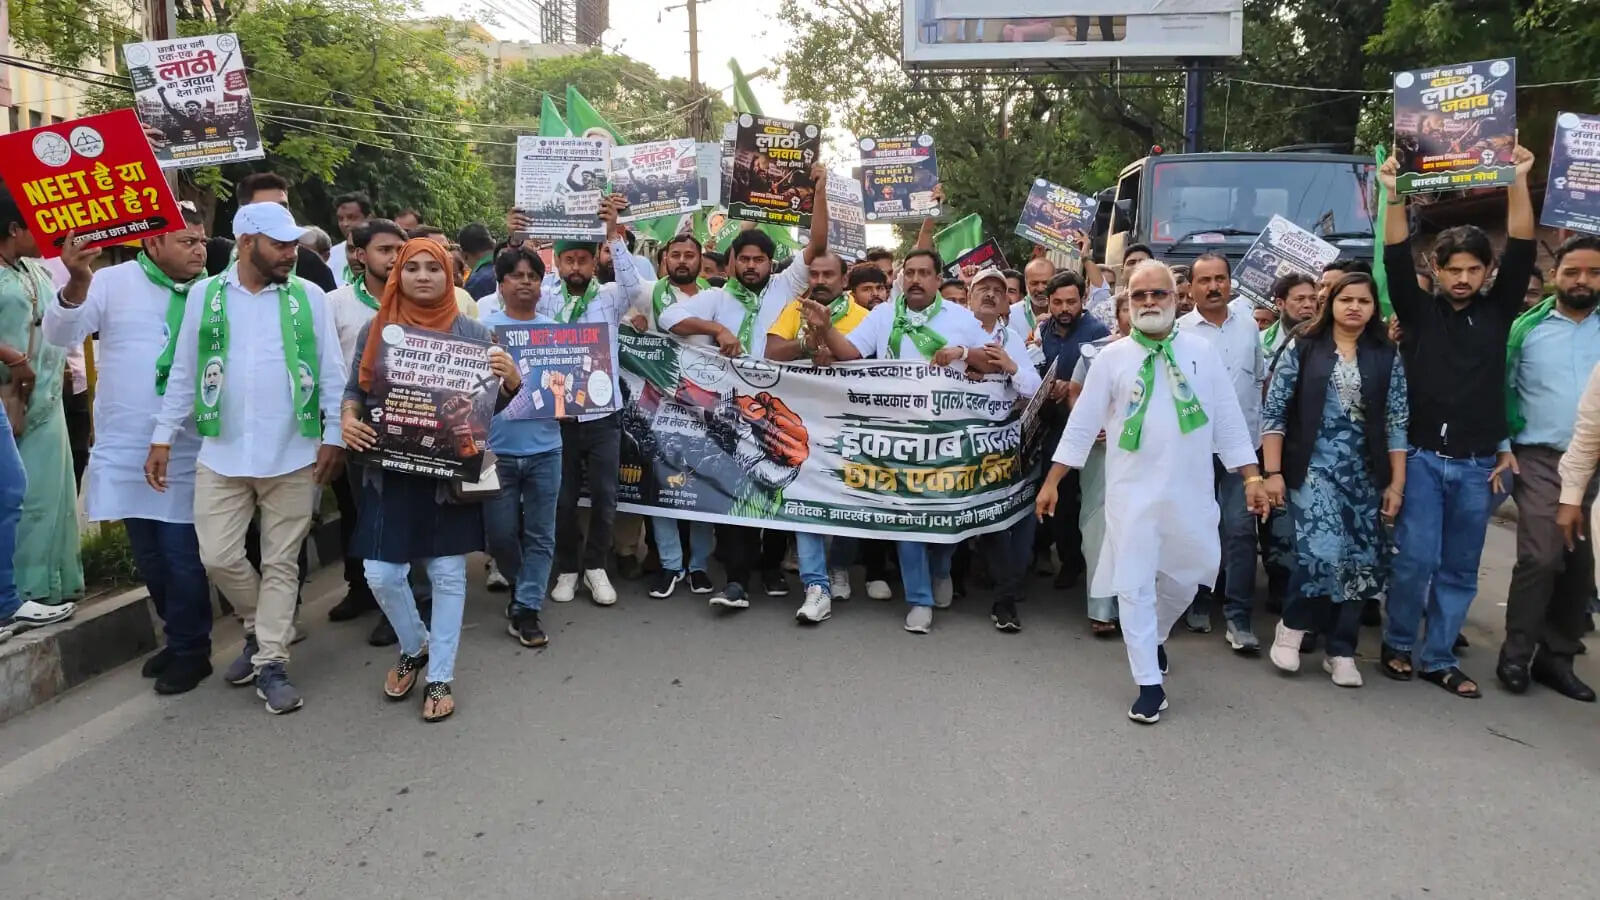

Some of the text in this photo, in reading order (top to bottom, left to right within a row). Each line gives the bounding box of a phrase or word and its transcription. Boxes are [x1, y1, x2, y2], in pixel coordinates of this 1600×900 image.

[158, 50, 193, 62] एक-एक
[177, 44, 187, 52] पर
[155, 49, 216, 80] लाठी
[1442, 69, 1453, 77] पर
[179, 75, 214, 88] जवाब
[1420, 74, 1484, 105] लाठी
[176, 87, 192, 97] देना
[1440, 94, 1489, 112] जवाब
[755, 131, 801, 149] लाठी
[631, 147, 676, 165] लाठी
[768, 148, 803, 161] जवाब
[1571, 148, 1594, 157] लाठी
[22, 160, 148, 206] NEET है या
[874, 176, 902, 185] CHEAT
[35, 194, 119, 235] CHEAT
[109, 226, 129, 238] छात्र
[128, 219, 151, 234] मोर्चा
[393, 348, 432, 363] जनता
[434, 350, 452, 366] की
[405, 336, 486, 360] सत्ता का अहंकार,
[394, 359, 403, 369] से
[419, 361, 437, 373] नहीं
[437, 363, 446, 374] हो
[696, 369, 715, 382] JCM
[390, 369, 416, 382] लाठी
[417, 372, 445, 389] भूलेंगे
[847, 388, 990, 416] केन्द्र सरकार का पुतला दहन
[655, 415, 669, 426] हम
[669, 413, 688, 428] लेकर
[841, 420, 964, 461] इंकलाब
[381, 459, 455, 478] झारखंड छात्र मोर्चा
[842, 461, 899, 492] छात्र
[902, 464, 979, 493] एकता
[784, 501, 827, 519] निवेदक:
[828, 507, 872, 524] झारखंड
[873, 510, 897, 525] छात्र
[898, 509, 928, 527] मोर्चा
[929, 516, 952, 528] JCM
